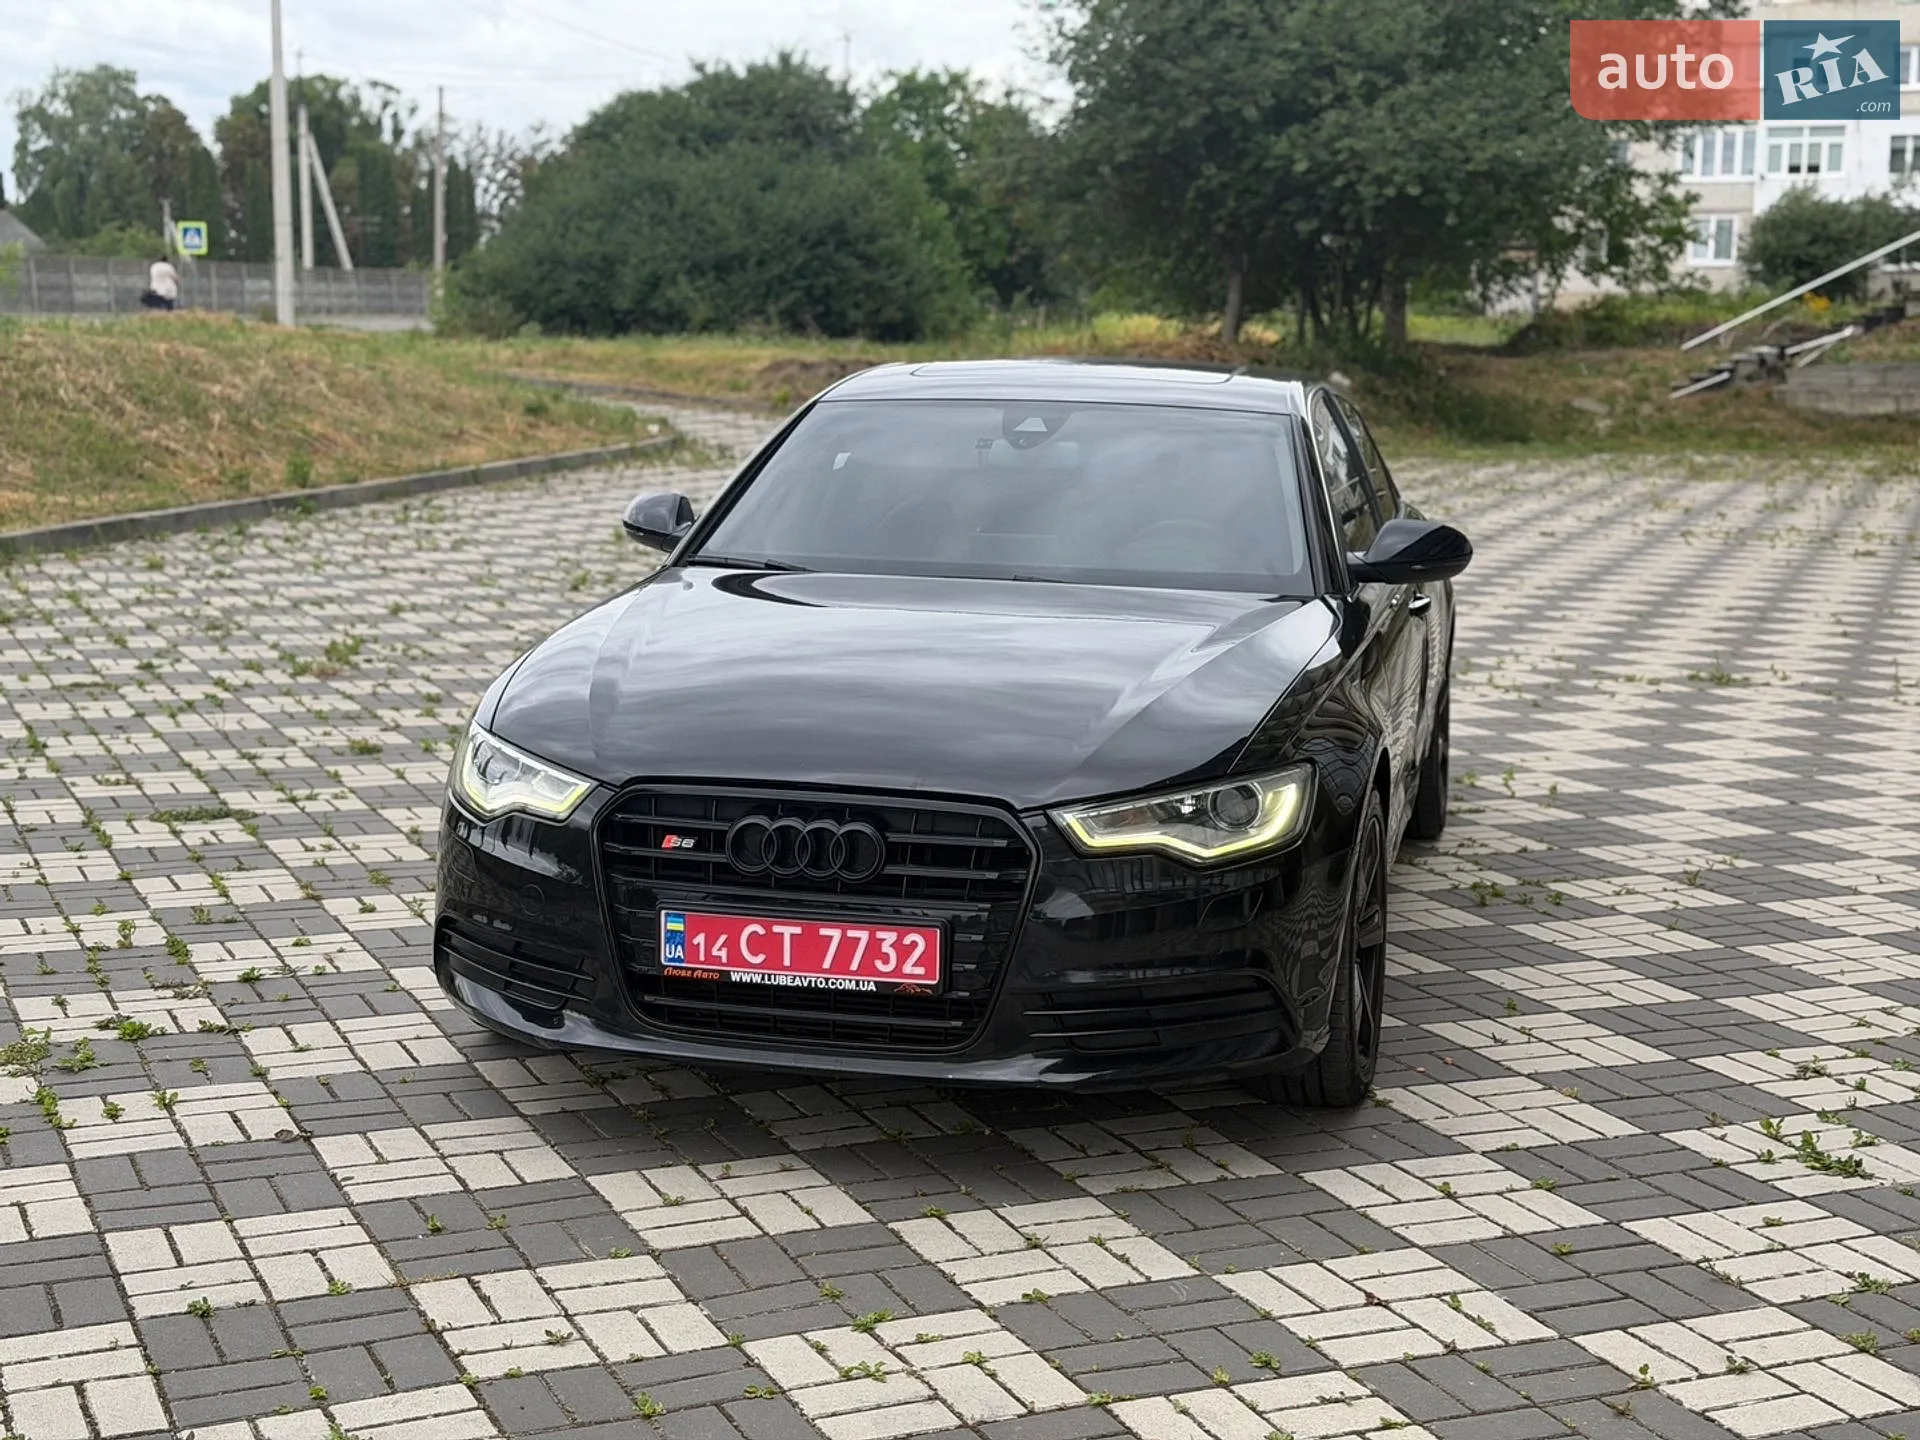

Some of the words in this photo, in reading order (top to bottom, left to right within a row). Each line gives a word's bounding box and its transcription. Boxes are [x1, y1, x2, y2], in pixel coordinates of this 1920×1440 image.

[666, 944, 684, 959] UA
[691, 932, 729, 963] 14
[739, 923, 803, 967] CT
[818, 928, 927, 975] 7732
[730, 971, 877, 992] WWW.LUBEAVTO.COM.UA
